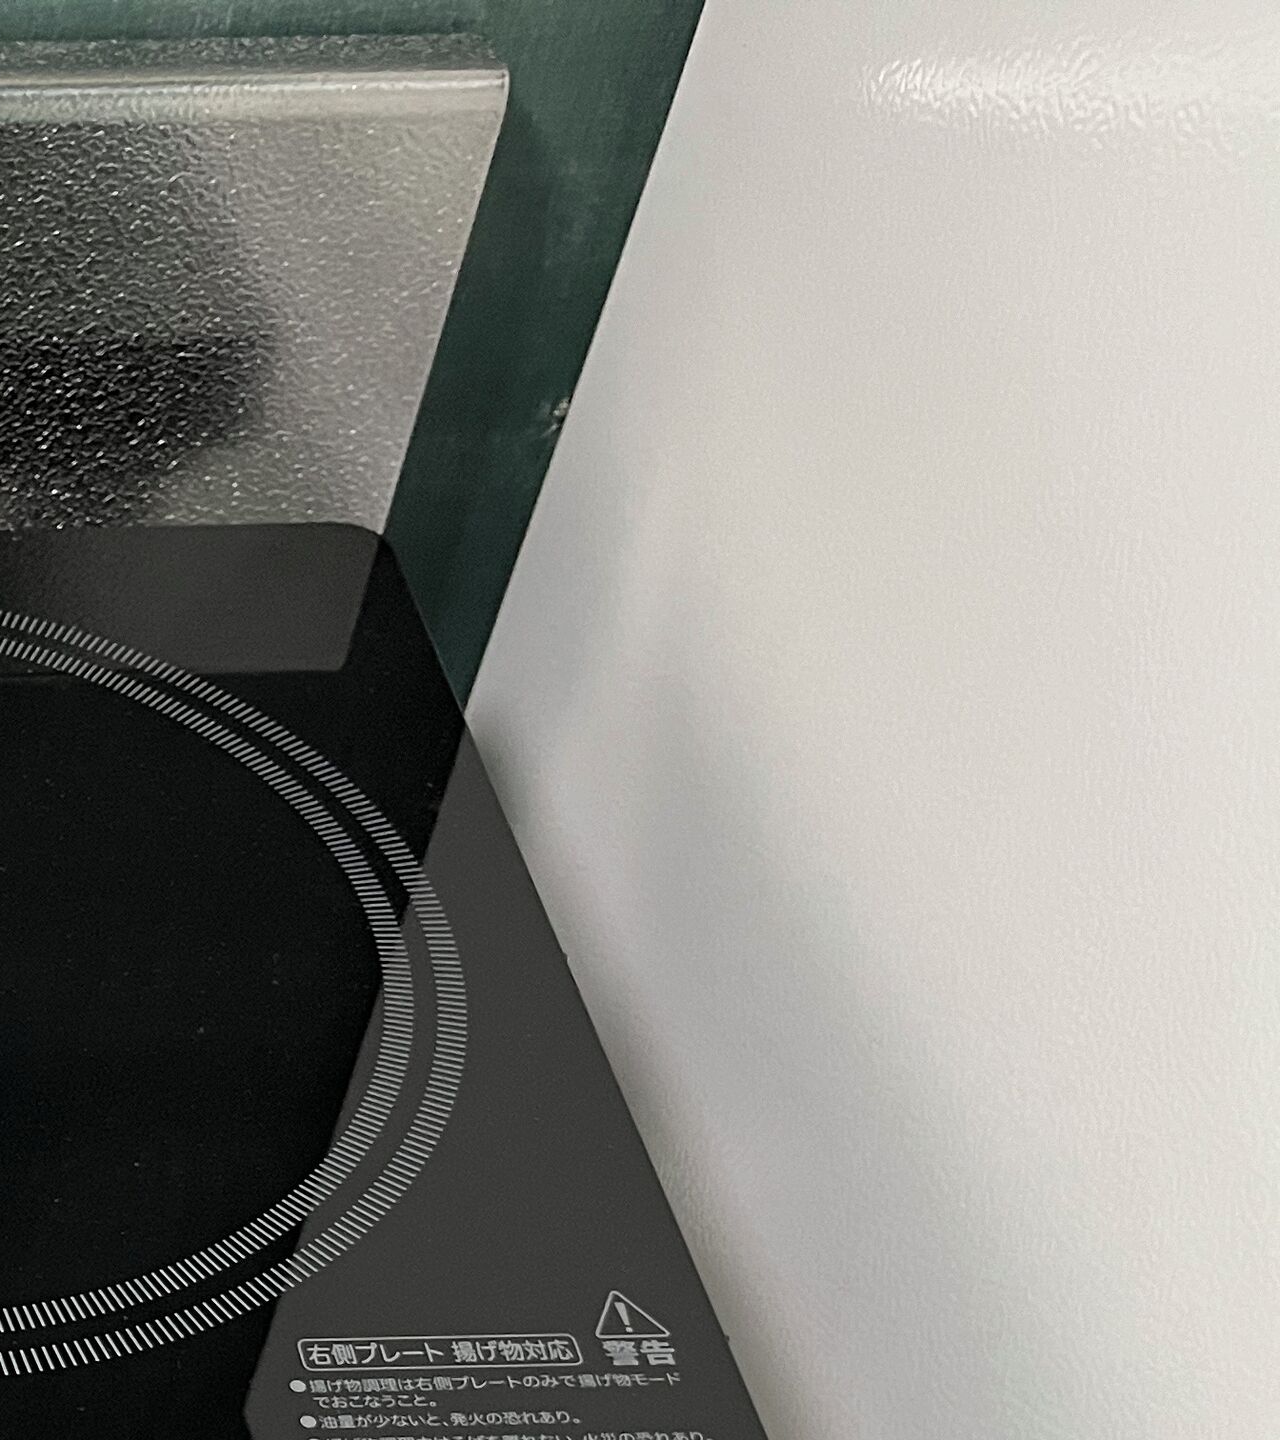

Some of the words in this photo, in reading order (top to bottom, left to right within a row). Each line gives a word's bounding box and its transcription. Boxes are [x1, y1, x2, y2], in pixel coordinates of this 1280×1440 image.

[307, 1341, 444, 1366] 右側プレート
[451, 1338, 573, 1363] 揚げ物対応
[602, 1339, 676, 1366] 警告
